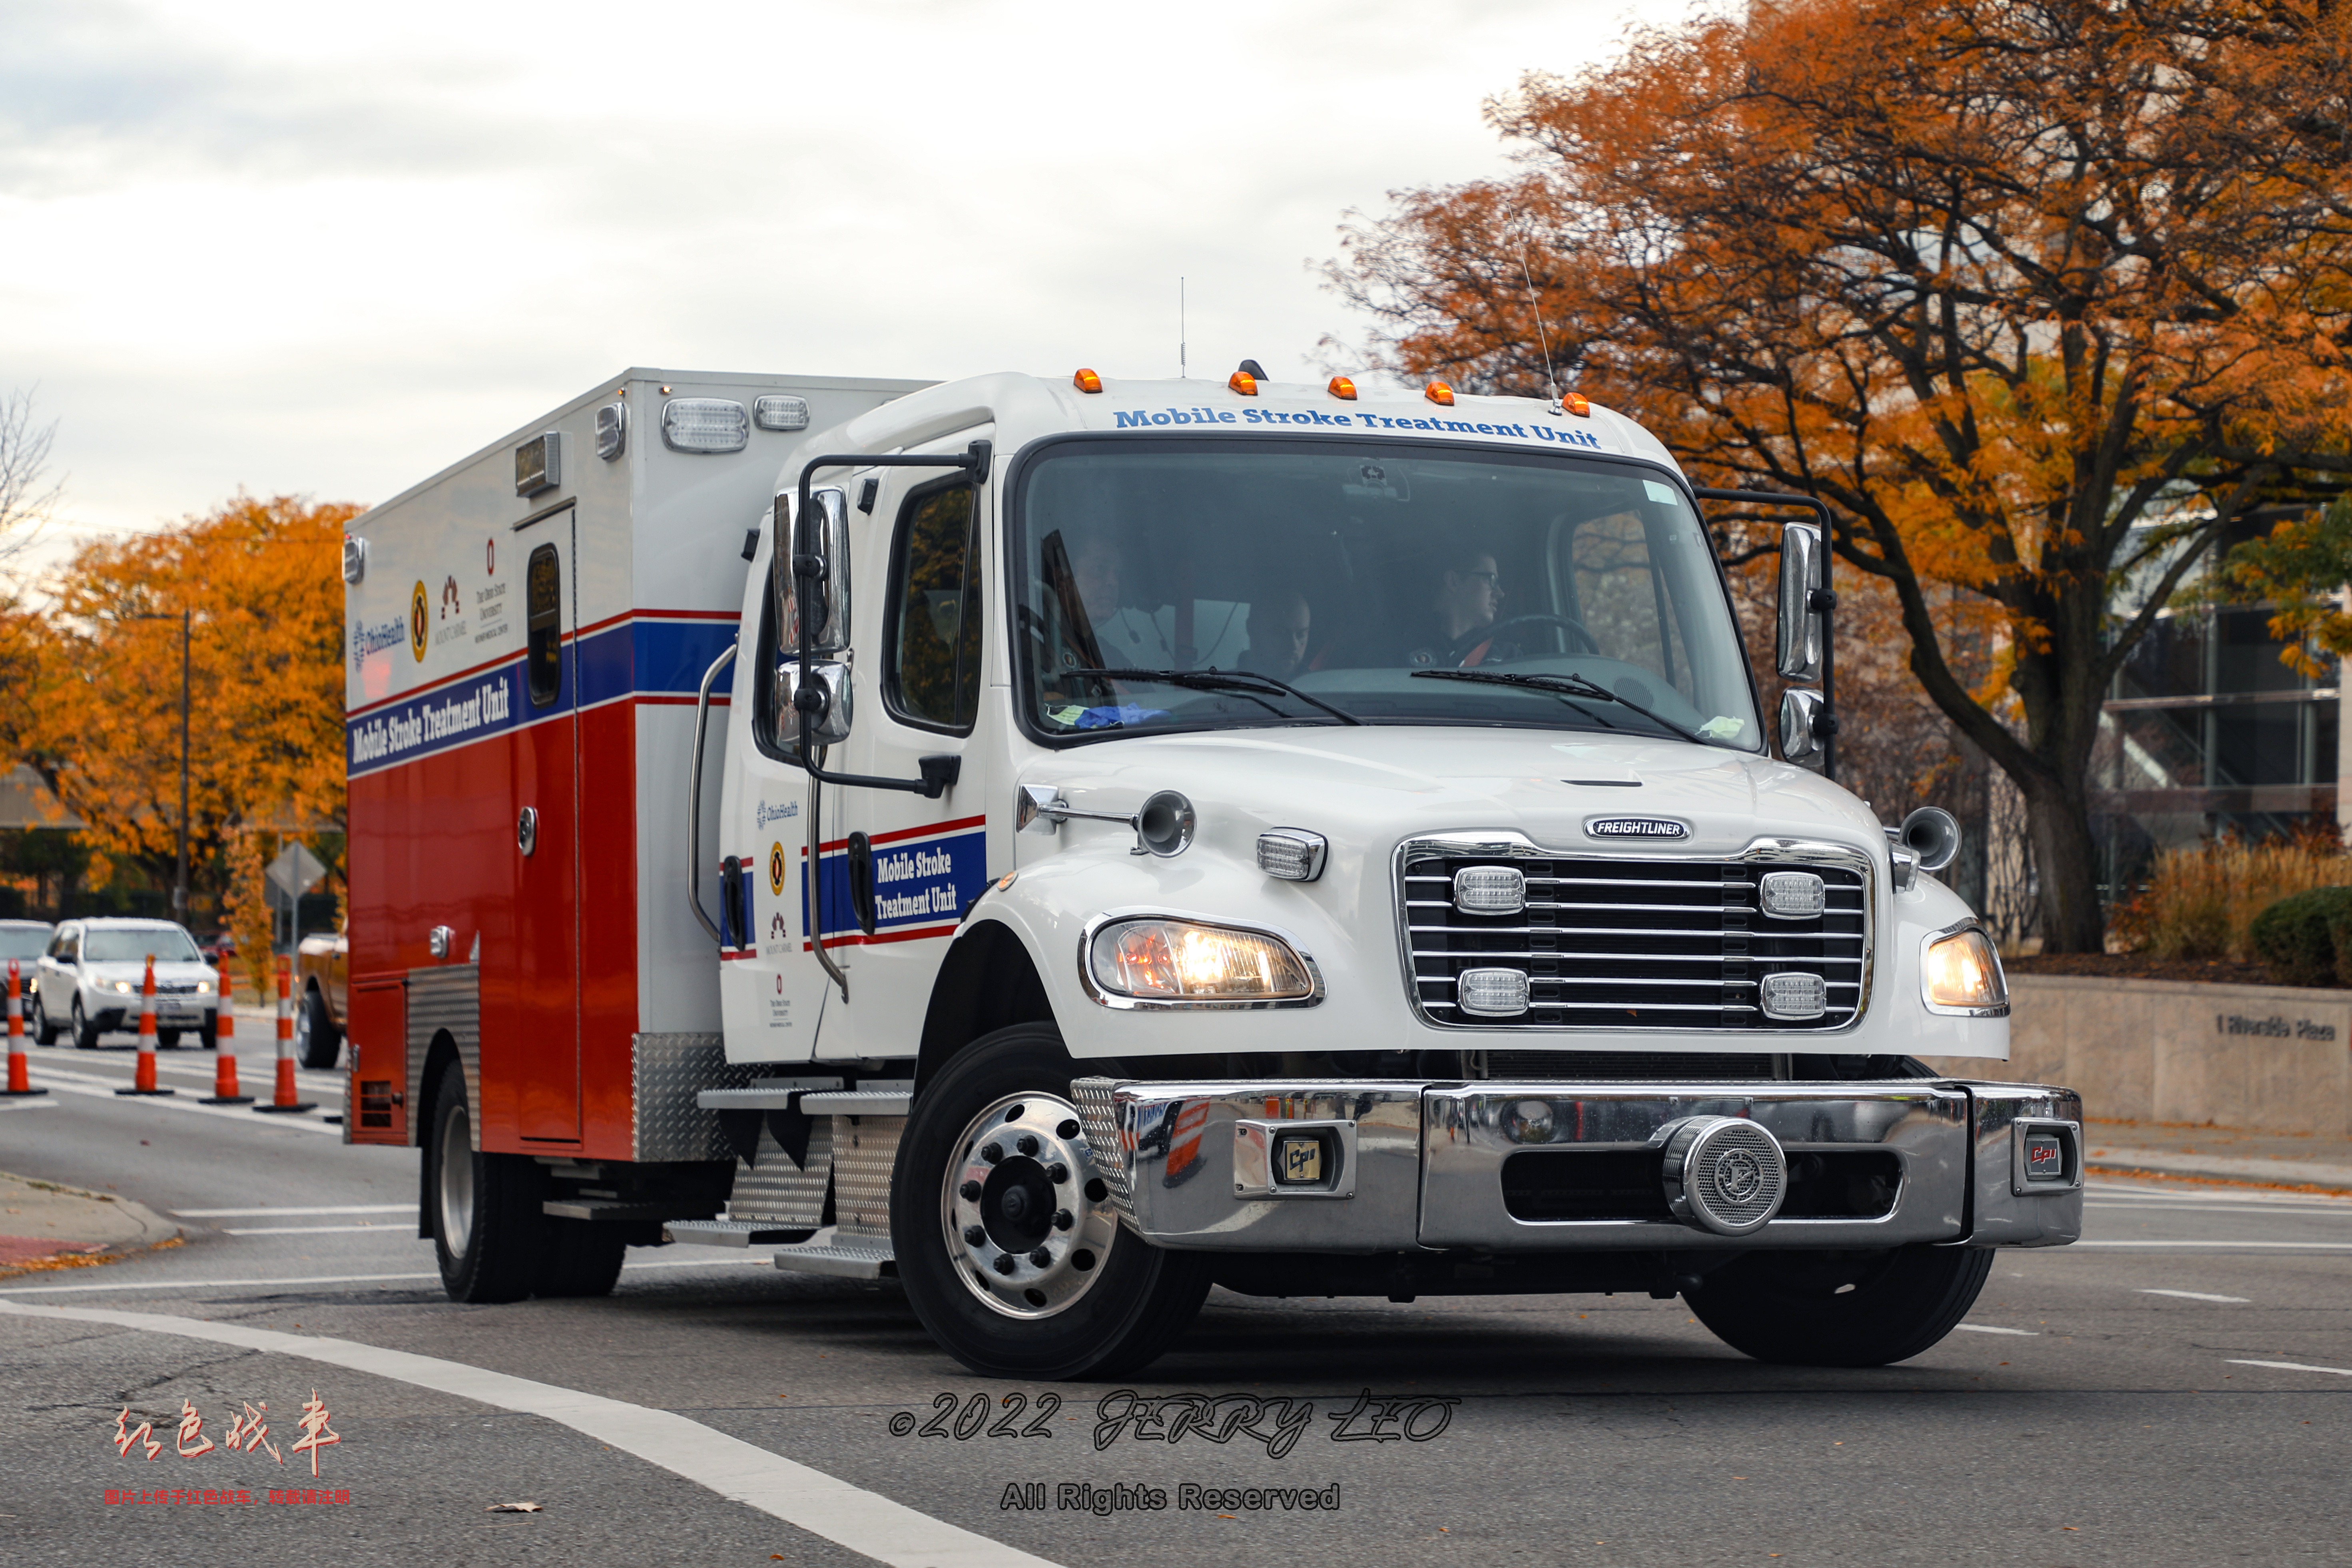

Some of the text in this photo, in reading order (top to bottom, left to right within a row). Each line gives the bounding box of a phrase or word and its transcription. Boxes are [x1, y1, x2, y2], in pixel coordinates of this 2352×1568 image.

[1113, 408, 1601, 450] Mobile Stroke Treatment Unit
[366, 616, 405, 655] OhioHealth
[353, 676, 509, 763] Mobile Stroke Treatment Unit
[767, 801, 797, 821] OhioHealth
[1597, 821, 1680, 835] FREIGHTLINER
[877, 847, 951, 883] Mobile Stroke
[875, 883, 957, 920] Treatment Unit
